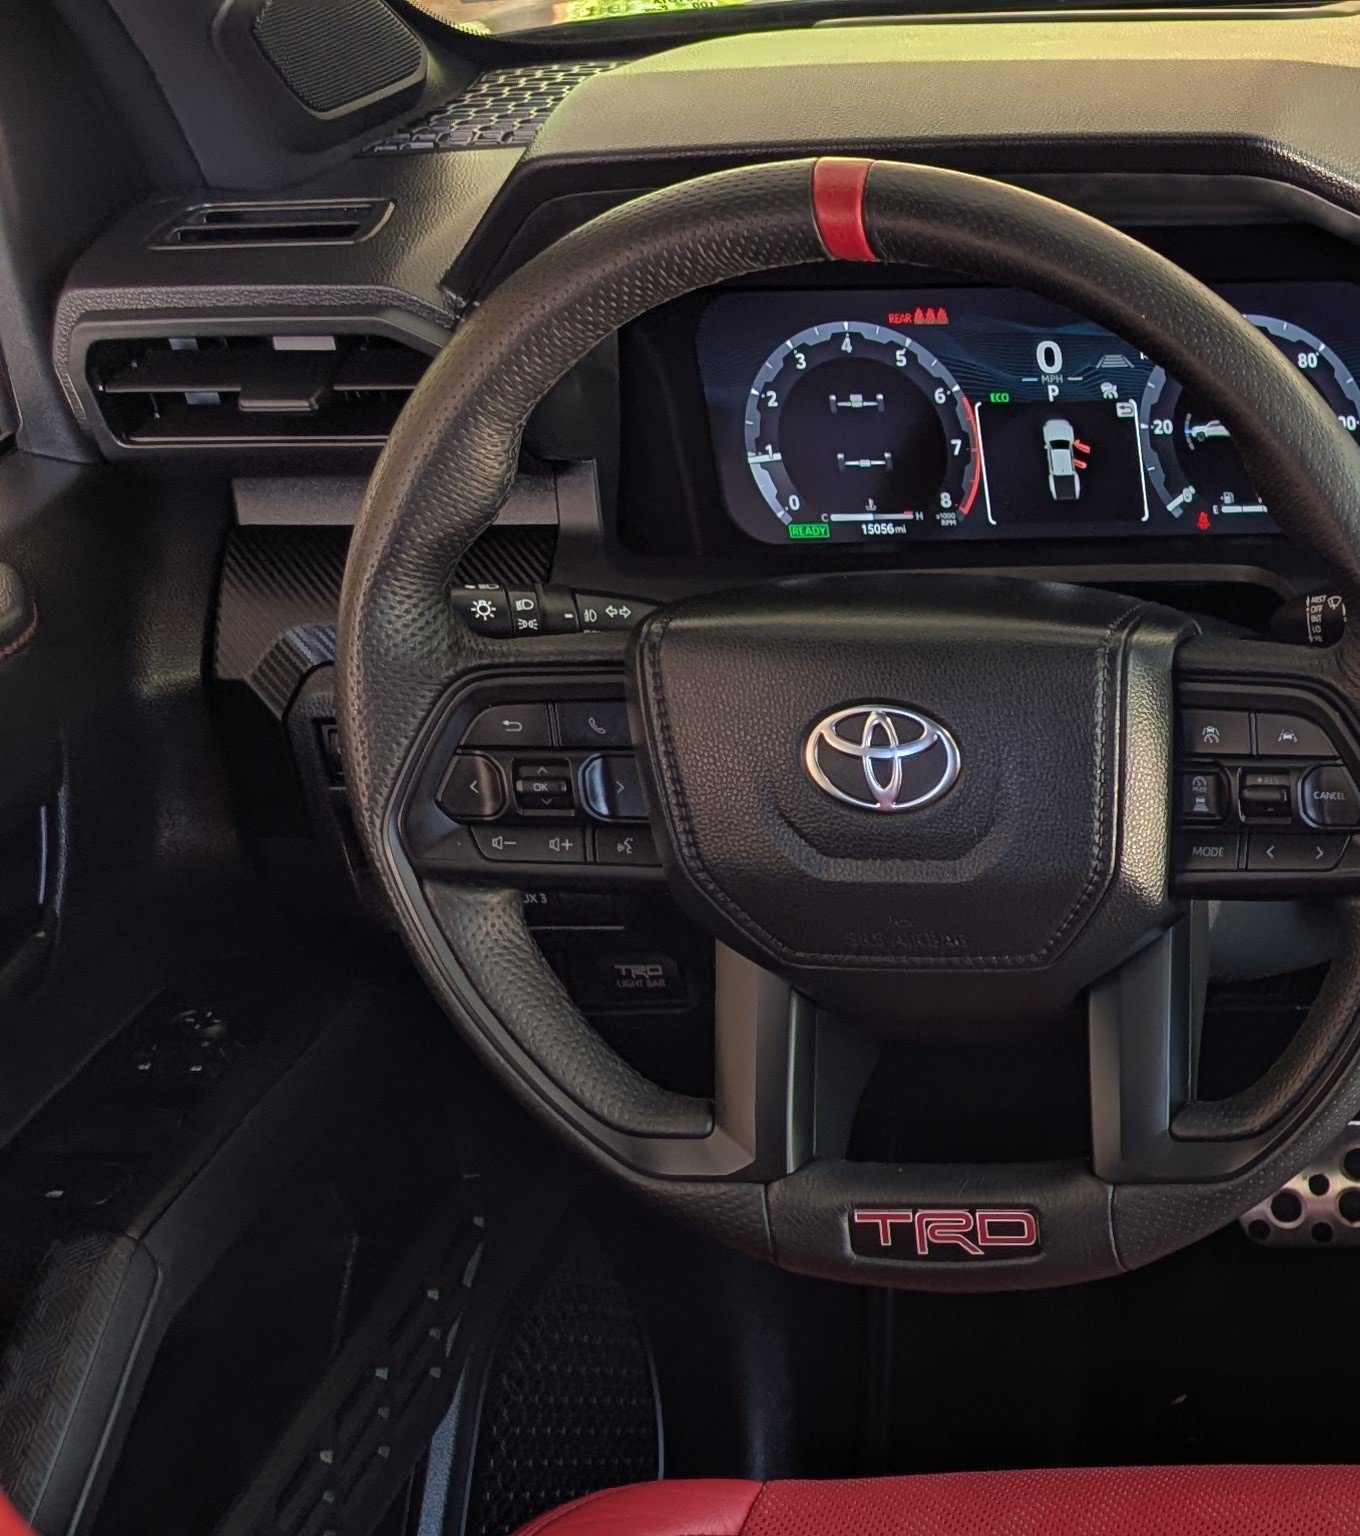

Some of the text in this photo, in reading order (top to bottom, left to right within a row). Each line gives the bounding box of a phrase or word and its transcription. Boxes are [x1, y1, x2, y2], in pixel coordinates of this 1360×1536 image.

[841, 337, 852, 353] 4
[795, 353, 807, 370] 3
[895, 350, 907, 367] 5
[1035, 340, 1063, 374] 0
[1297, 352, 1318, 368] 80
[1041, 374, 1064, 384] MPH
[767, 391, 778, 407] 2
[934, 387, 946, 404] 6
[989, 392, 1010, 403] ECO
[1047, 384, 1060, 402] P
[1153, 418, 1174, 435] 20
[950, 439, 962, 456] 7
[788, 494, 800, 511] 0
[940, 492, 952, 508] 8
[791, 526, 826, 536] READY
[532, 782, 548, 792] OK
[1313, 790, 1345, 801] CANCEL
[1191, 846, 1225, 857] MODE
[614, 964, 663, 978] TRD
[854, 1208, 1037, 1256] TRD
